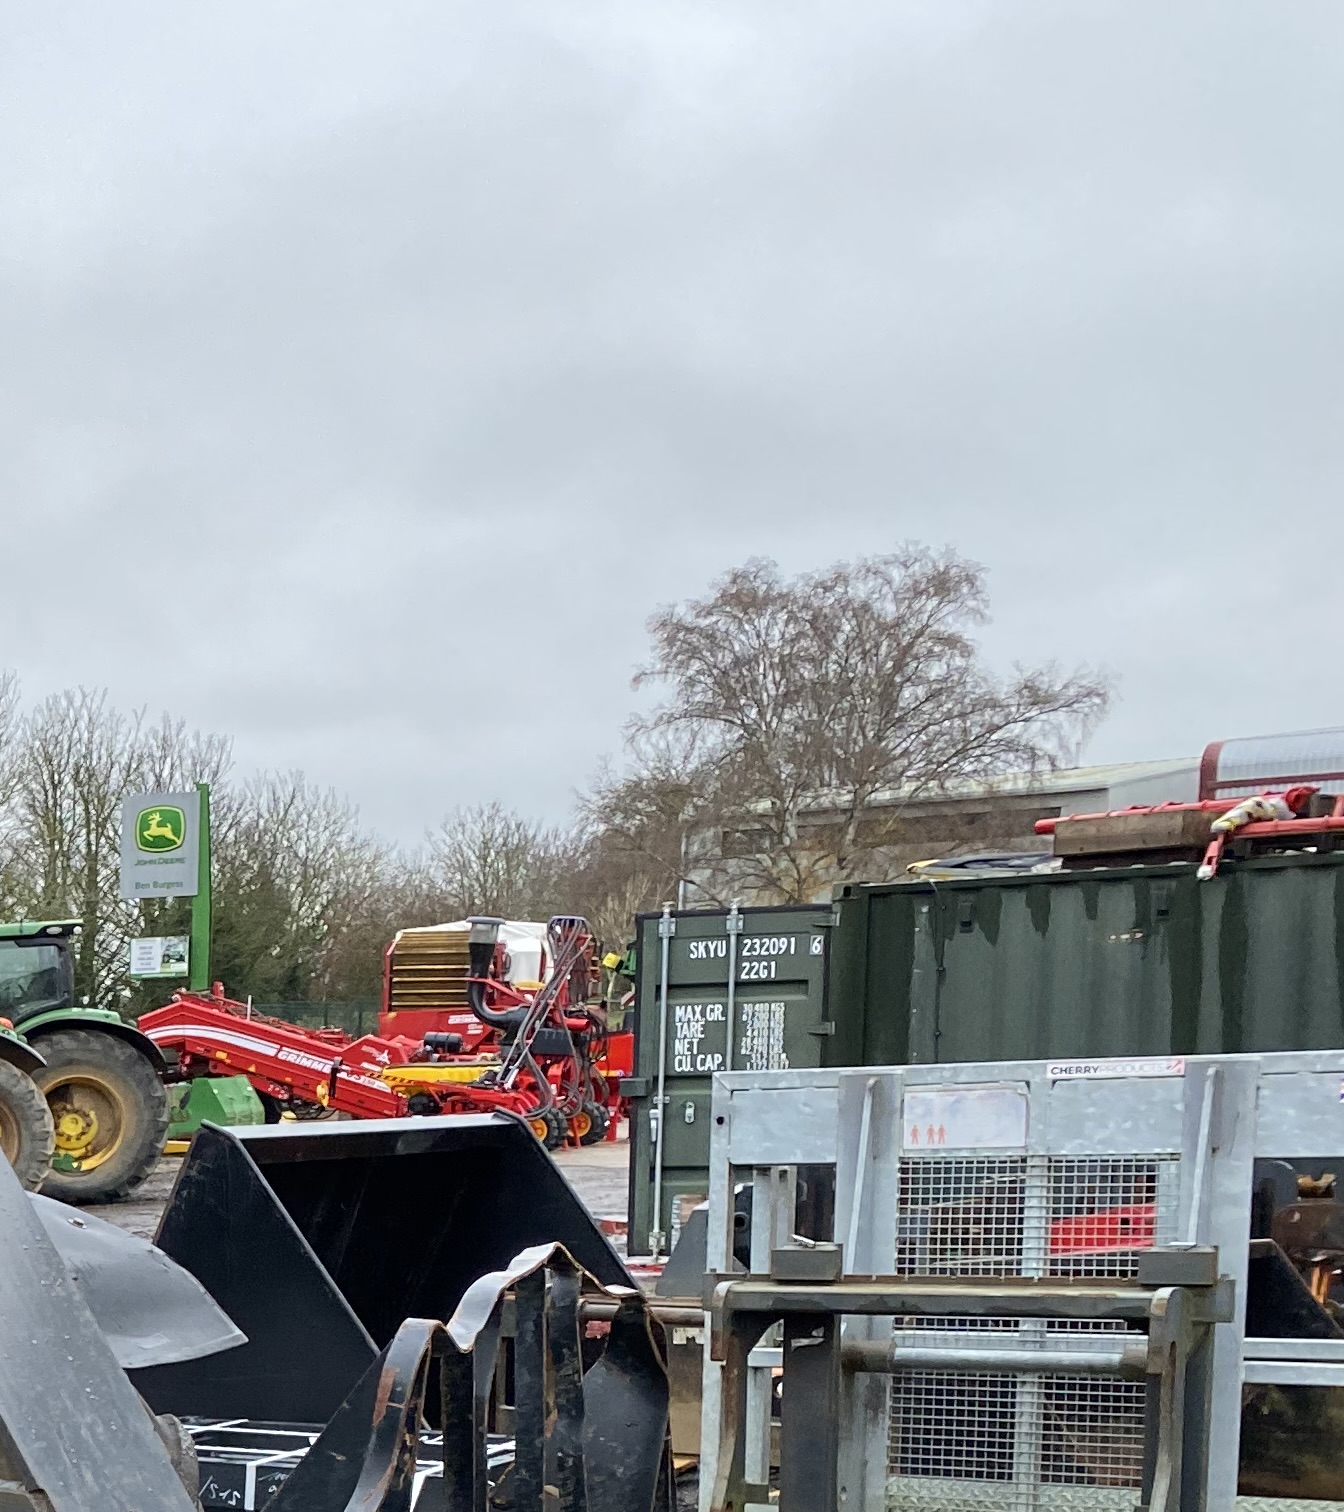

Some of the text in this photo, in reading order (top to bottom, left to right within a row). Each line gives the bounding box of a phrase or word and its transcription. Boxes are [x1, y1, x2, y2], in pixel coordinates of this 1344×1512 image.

[135, 880, 184, 890] Ben Burgess
[689, 937, 821, 959] SKYU 232091 6
[740, 961, 776, 979] 22G1
[675, 1021, 705, 1039] TARE
[675, 1038, 699, 1055] NET
[696, 1053, 725, 1071] CAP.
